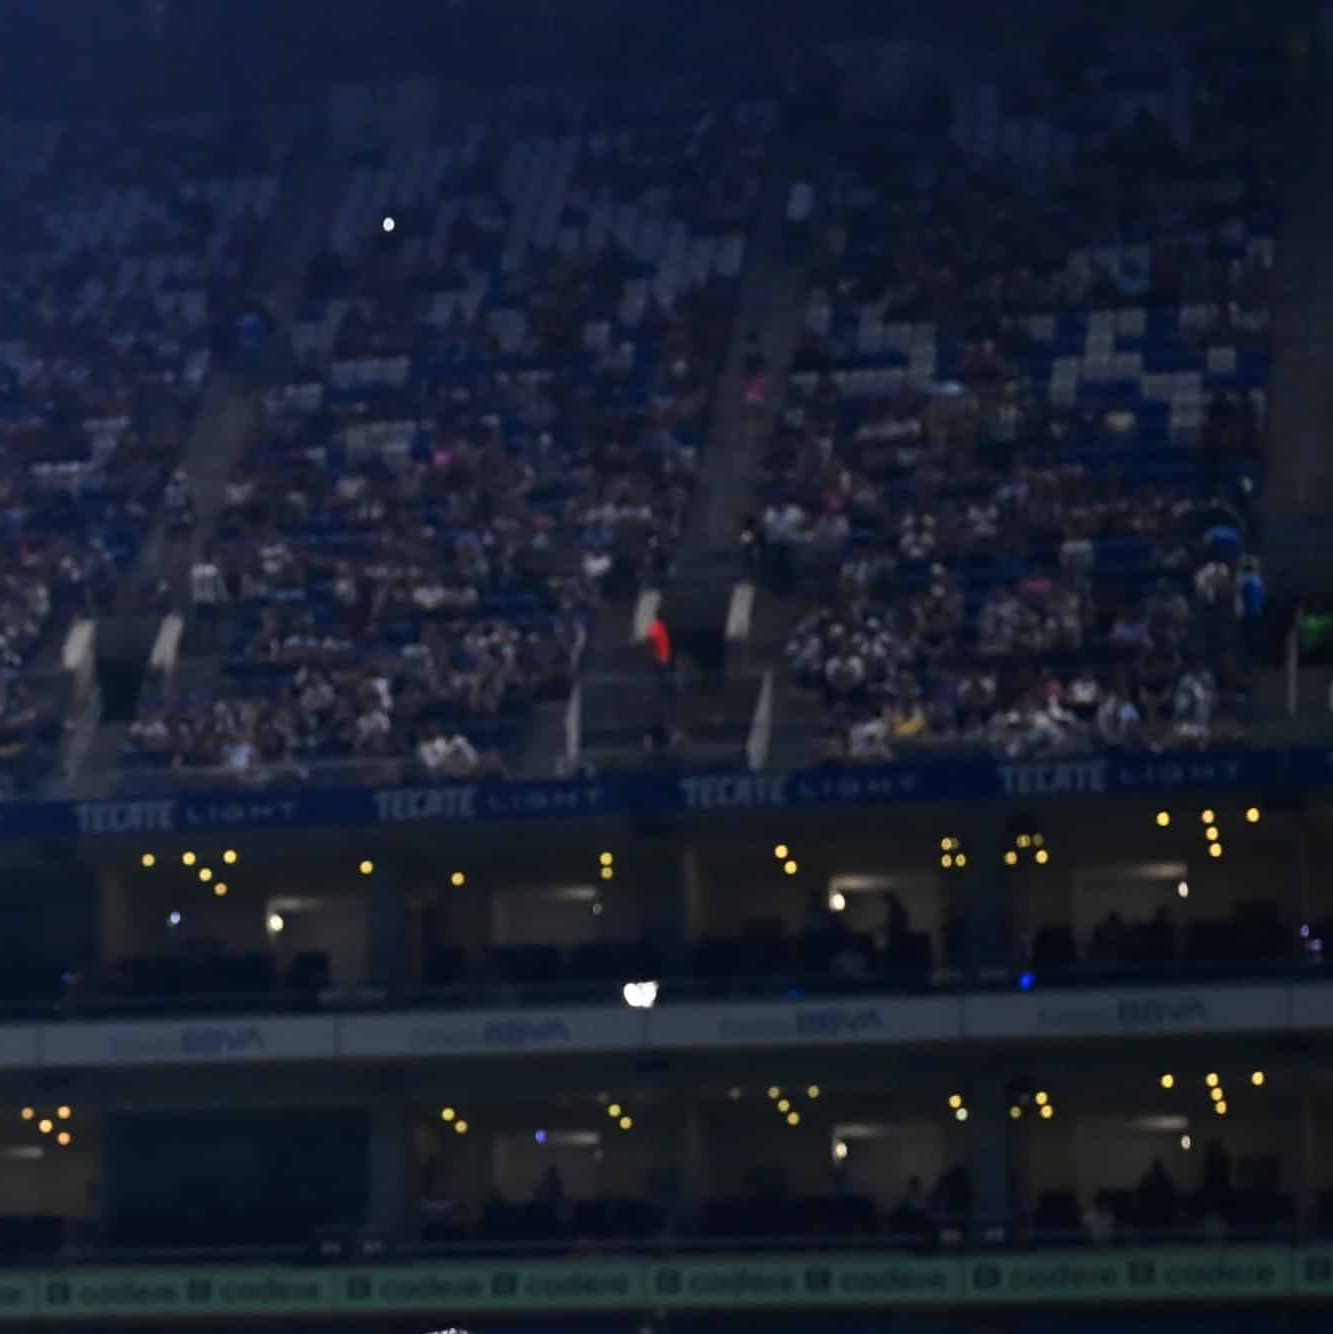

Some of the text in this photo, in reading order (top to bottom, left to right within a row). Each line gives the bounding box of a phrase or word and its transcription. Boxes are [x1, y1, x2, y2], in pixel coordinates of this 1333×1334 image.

[681, 775, 786, 808] TECATE
[997, 758, 1108, 792] TECATE
[75, 800, 175, 833] TECATE
[373, 787, 478, 822] TECATE
